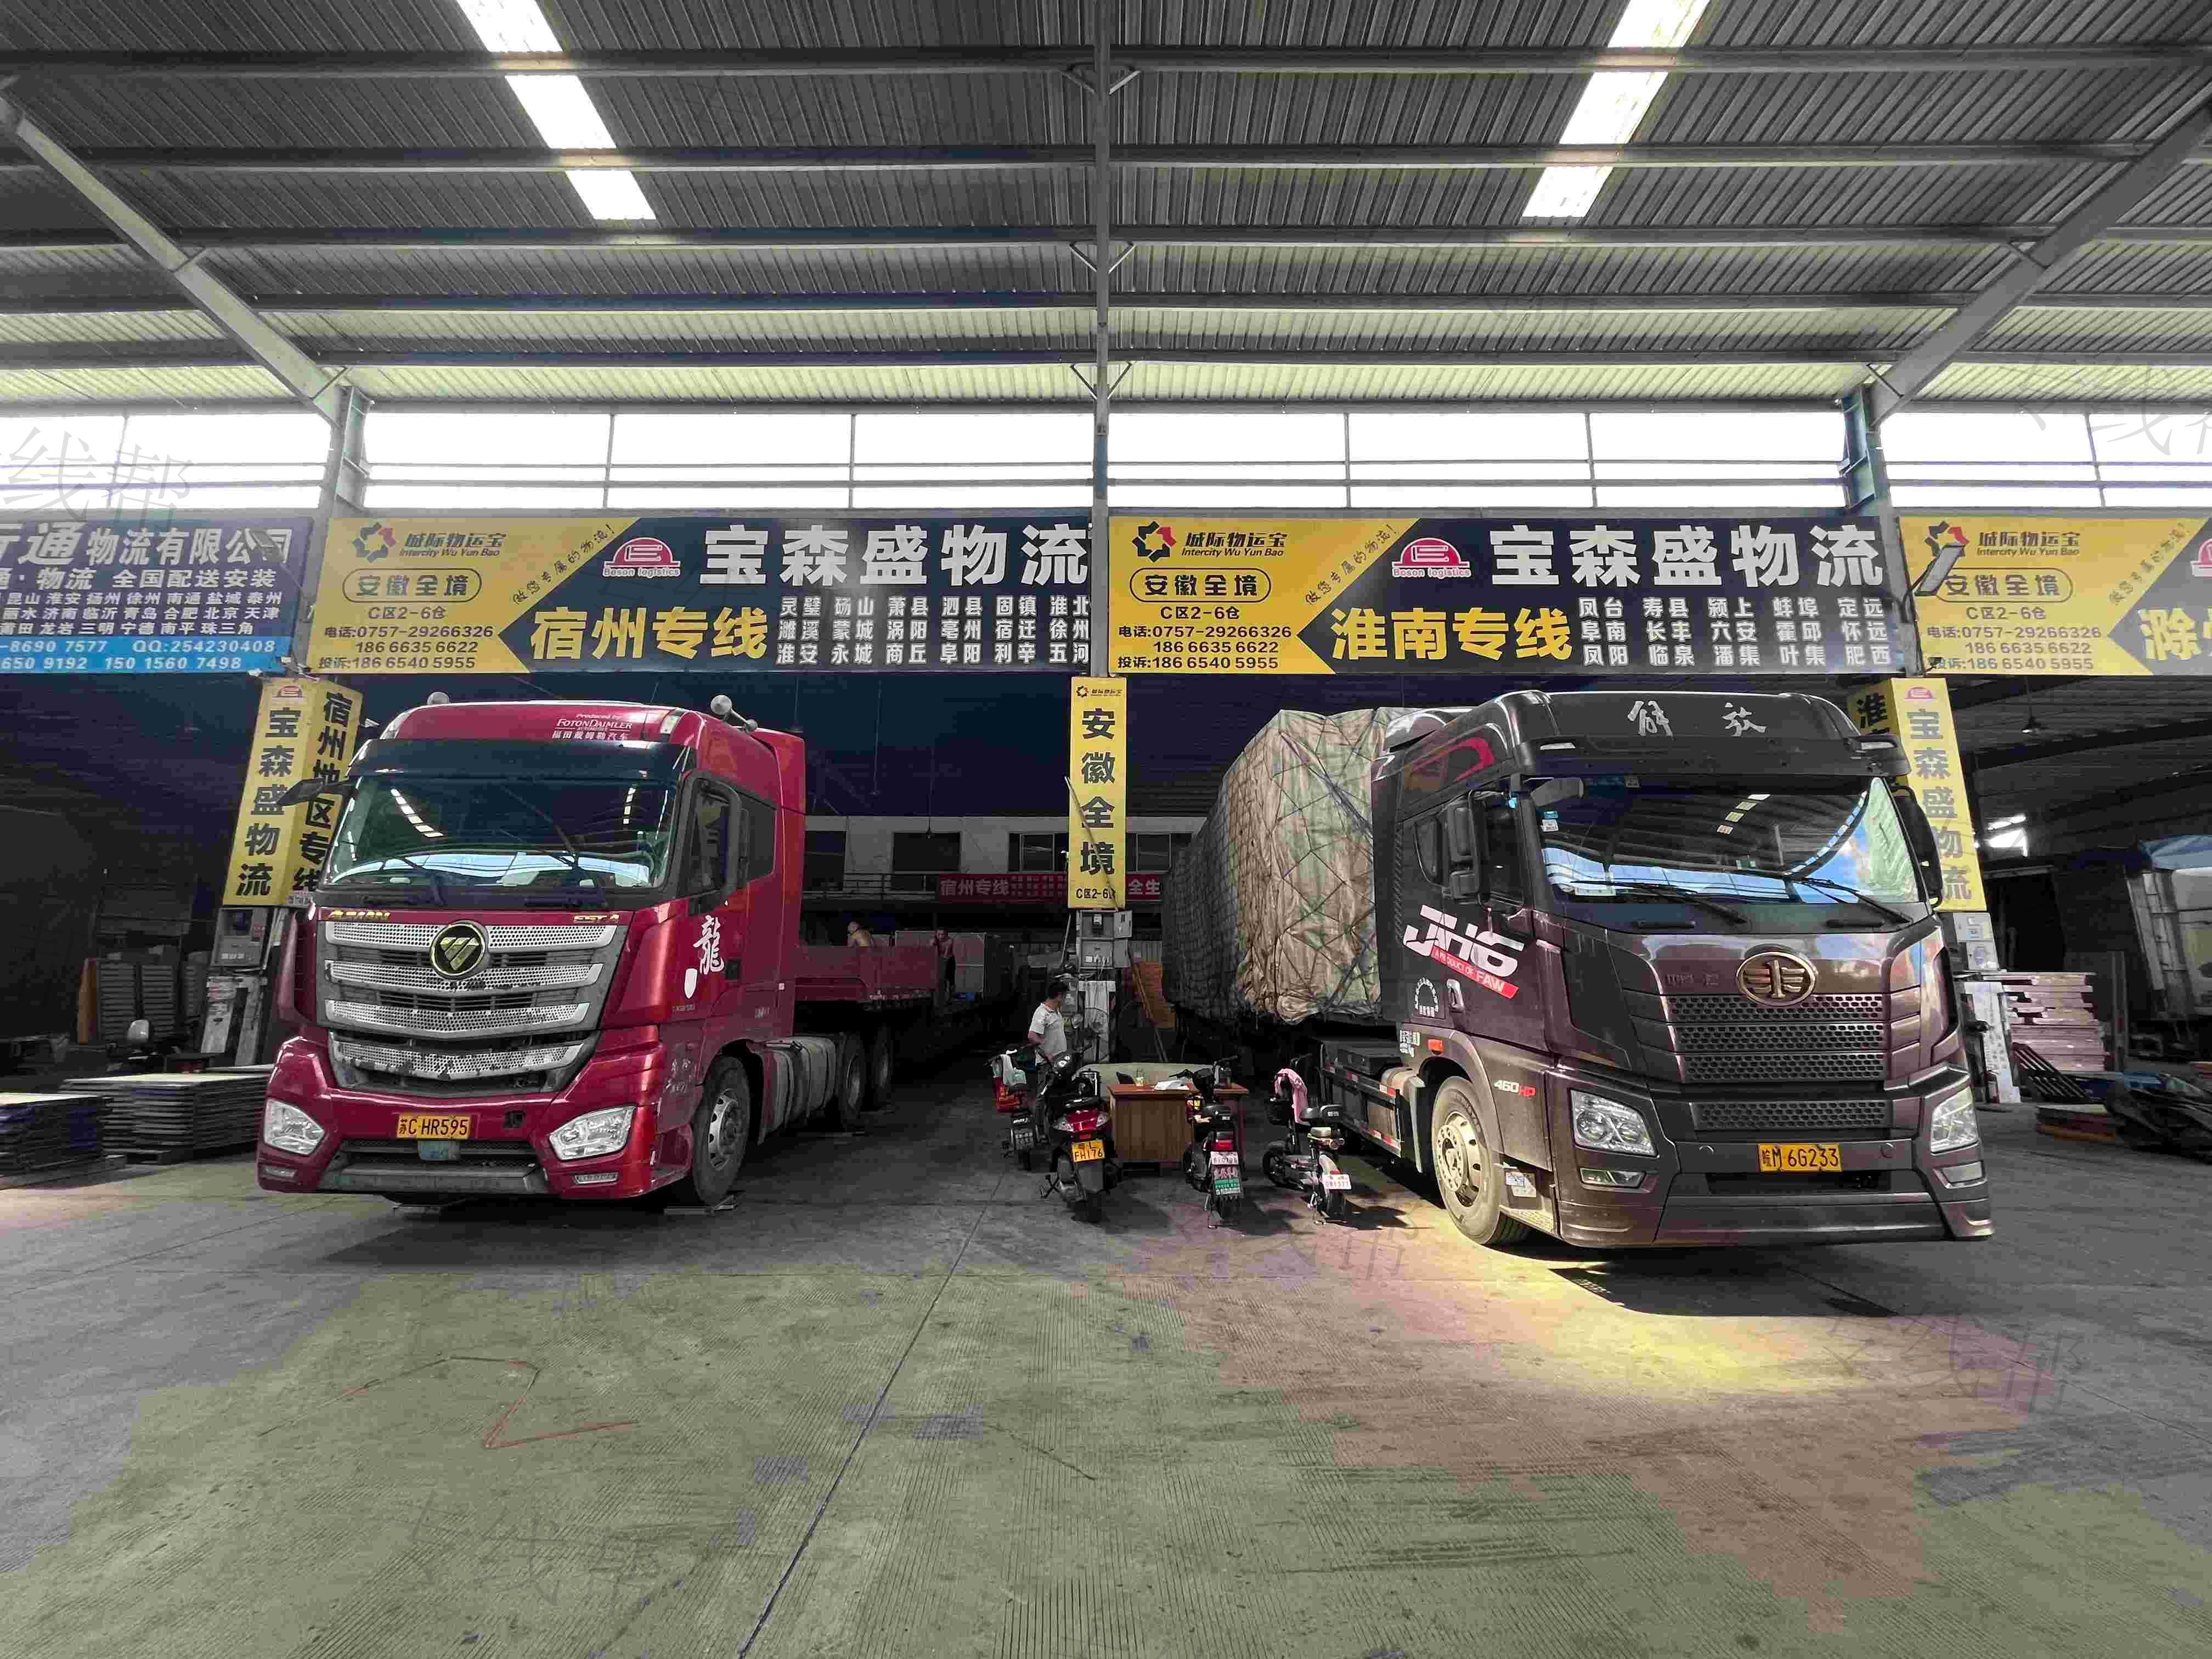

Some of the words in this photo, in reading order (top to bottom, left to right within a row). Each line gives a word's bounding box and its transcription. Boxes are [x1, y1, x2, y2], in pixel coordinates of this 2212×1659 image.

[1185, 532, 1288, 549] 城际物运宝
[699, 524, 1088, 586] 宝森盛物流
[1181, 548, 1222, 558] Intercity
[1224, 548, 1241, 557] Wu
[1244, 548, 1262, 557] Yun
[1264, 549, 1284, 557] Bao
[1489, 524, 1883, 587] 宝森盛物流
[112, 569, 277, 589] 全国配送安装
[1428, 567, 1471, 578] logistics
[357, 574, 467, 597] 安徽全境
[1144, 574, 1257, 597] 安徽全境
[1944, 574, 2061, 596] 安徽全境
[7, 592, 40, 604] 昆山
[127, 592, 161, 605] 徐州
[167, 592, 202, 605] 南通
[206, 592, 241, 604] 盐城
[780, 596, 821, 617] 灵璧
[834, 596, 874, 616] 砀山
[888, 596, 928, 617] 萧县
[941, 596, 983, 616] 泗县
[996, 595, 1036, 617] 固镇
[1049, 595, 1088, 617] 淮北
[1578, 597, 1624, 618] 凤台
[1642, 597, 1689, 618] 寿县
[1772, 596, 1819, 618] 蚌埠
[1837, 597, 1884, 618] 定远
[42, 607, 78, 619] 济南
[83, 607, 118, 619] 临沂
[123, 607, 157, 619] 青岛
[163, 607, 199, 619] 合肥
[203, 607, 239, 619] 北京
[244, 607, 280, 619] 天津
[368, 606, 447, 619] C区2-6仓
[1160, 606, 1239, 619] C区2-6仓
[39, 623, 75, 635] 龙岩
[78, 623, 115, 635] 三明
[120, 623, 155, 635] 宁德
[161, 623, 195, 635] 南平
[200, 623, 254, 635] 珠三角
[324, 626, 493, 638] 电话:0757-29266326
[530, 606, 768, 659] 宿州专线
[777, 619, 820, 641] 濉溪
[833, 619, 874, 641] 蒙城
[886, 619, 927, 641] 涡阳
[996, 619, 1036, 640] 宿迁
[1049, 619, 1088, 640] 徐州
[1118, 626, 1291, 637] 电话:0757-29266326
[1331, 607, 1572, 660] 淮南专线
[1581, 620, 1627, 642] 阜南
[1645, 620, 1692, 642] 长丰
[1711, 620, 1758, 642] 六安
[1776, 620, 1821, 642] 霍邱
[1842, 620, 1888, 642] 怀远
[2138, 607, 2212, 661] 滁
[65, 641, 108, 652] 7577
[132, 640, 275, 652] QQ:254230408
[356, 641, 385, 653] 186
[388, 641, 431, 653] 6635
[436, 641, 478, 653] 6622
[776, 643, 817, 665] 淮安
[831, 643, 873, 664] 永城
[886, 643, 927, 664] 商丘
[940, 642, 981, 664] 阜阳
[1049, 642, 1088, 664] 五河
[1154, 641, 1183, 653] 186
[1188, 641, 1231, 653] 6635
[1235, 641, 1278, 653] 6622
[1965, 642, 1996, 653] 186
[2000, 642, 2044, 653] 6635
[2048, 642, 2092, 653] 6622
[43, 657, 88, 669] 9192
[105, 658, 136, 669] 150
[144, 657, 187, 669] 1560
[196, 657, 241, 669] 7498
[386, 657, 428, 669] 6540
[433, 657, 475, 669] 5955
[1118, 657, 1182, 668] 投诉:186
[1187, 657, 1230, 668] 6540
[1235, 657, 1278, 668] 5955
[1583, 645, 1629, 666] 凤阳
[1648, 644, 1696, 667] 临泉
[1779, 645, 1826, 667] 叶集
[1845, 644, 1892, 666] 肥西
[2002, 658, 2046, 669] 6540
[2051, 658, 2093, 669] 5955
[1080, 708, 1115, 875] 安徽全境
[235, 707, 301, 896] 宝森盛物流
[1906, 708, 1972, 900] 宝森盛物流
[940, 878, 1010, 895] 宿州专线
[1475, 971, 1505, 992] FAW
